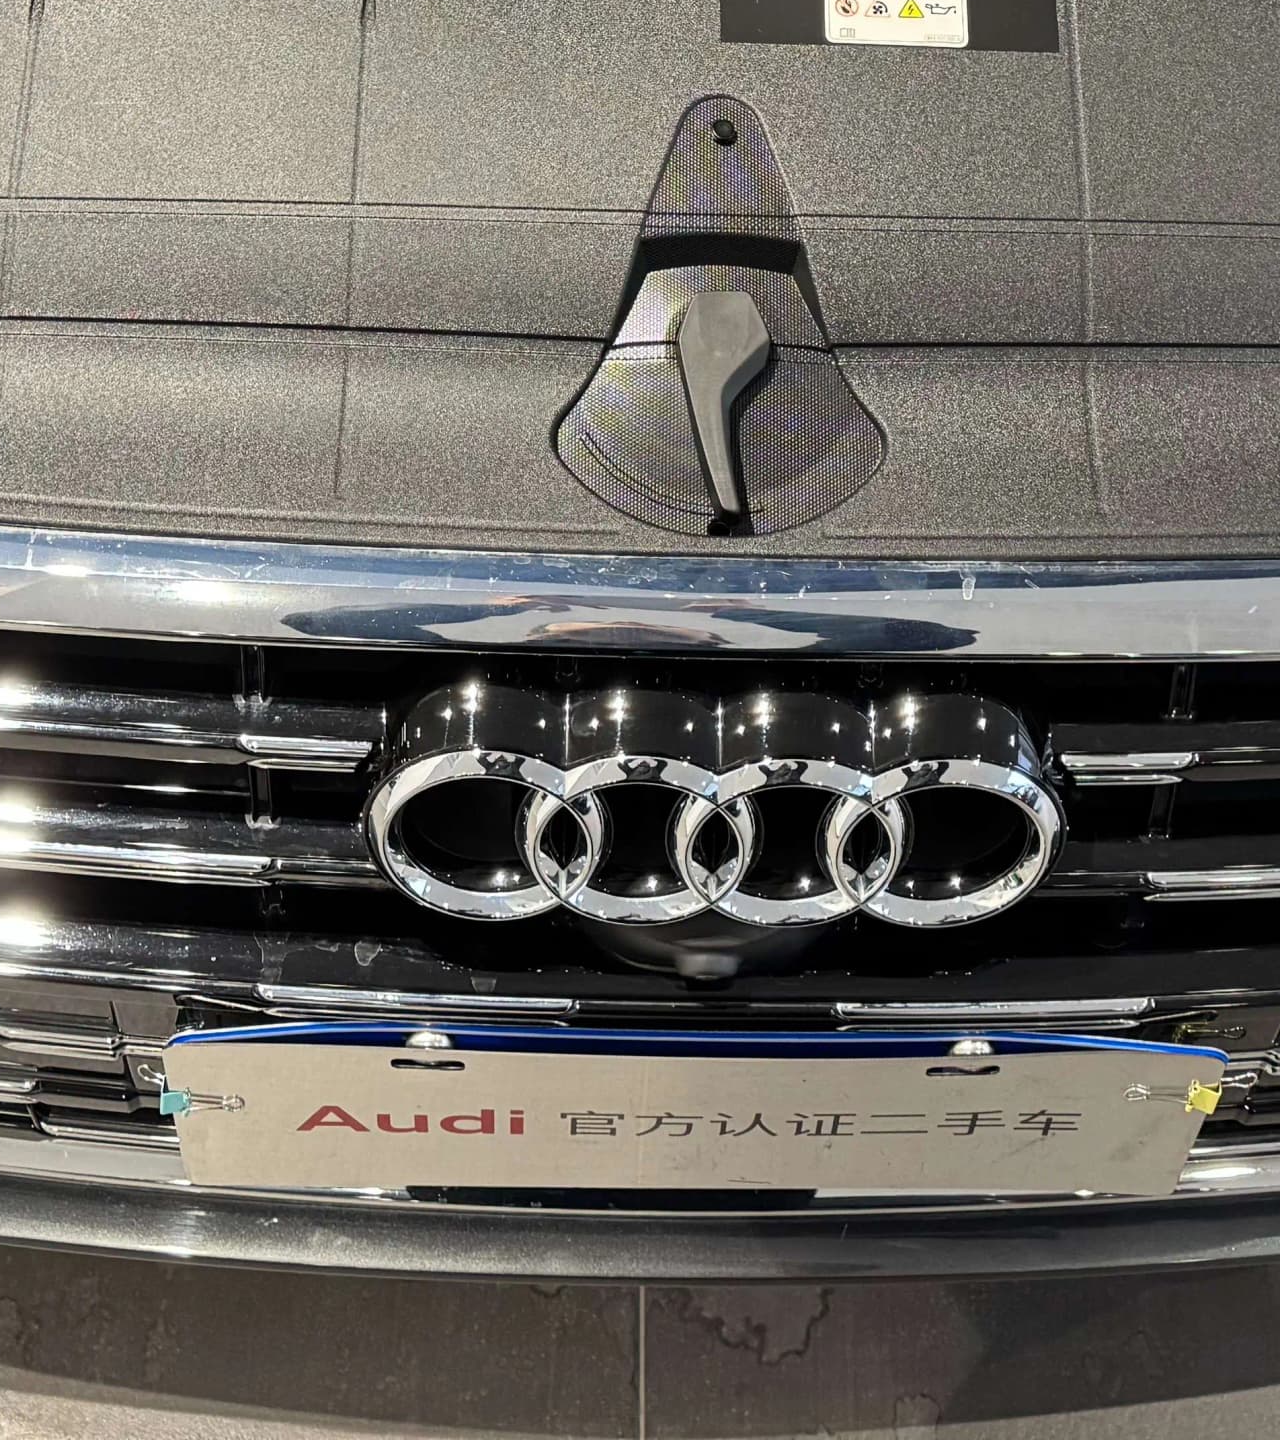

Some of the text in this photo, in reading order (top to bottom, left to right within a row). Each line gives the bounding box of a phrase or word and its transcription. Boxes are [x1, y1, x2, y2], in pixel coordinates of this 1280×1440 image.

[296, 1105, 1083, 1137] Audi 官方认证二手车
